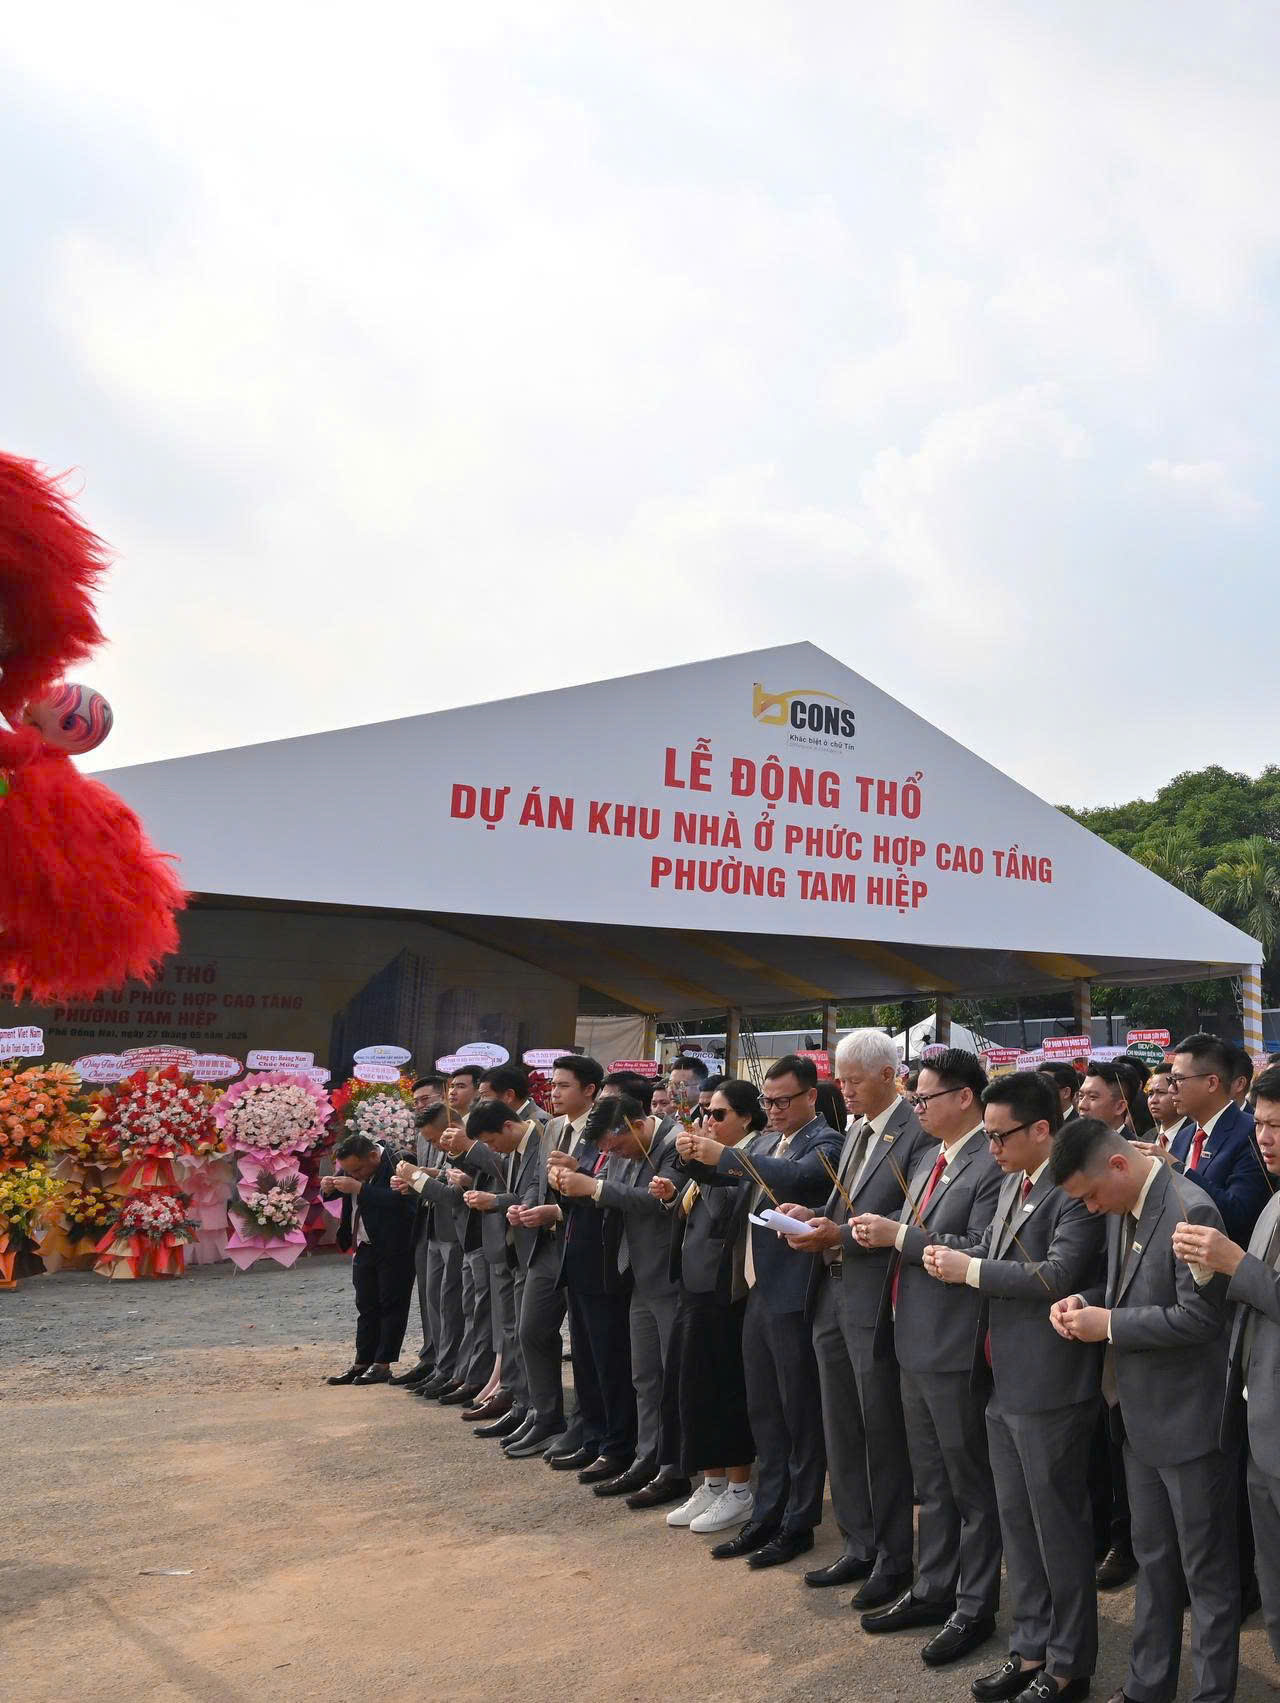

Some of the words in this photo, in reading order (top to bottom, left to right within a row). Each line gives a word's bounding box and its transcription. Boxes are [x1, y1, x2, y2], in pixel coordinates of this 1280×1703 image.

[664, 736, 713, 793] LỄ
[731, 754, 841, 809] ĐỘNG
[856, 771, 926, 820] THỔ
[450, 784, 511, 831] DỰ
[519, 786, 575, 830] ÁN
[588, 801, 661, 841] KHU
[673, 809, 742, 849] NHÀ
[754, 811, 776, 852] Ở
[785, 822, 863, 863] PHỨC
[873, 834, 927, 874] HỢP
[936, 843, 985, 874] CAO
[992, 843, 1053, 884] TẦNG
[651, 855, 786, 899] PHƯỜNG
[798, 870, 857, 904] TAM
[867, 874, 929, 914] HIỆP
[53, 1005, 129, 1023] PHƯỜNG
[136, 1010, 171, 1024] TAM
[224, 993, 255, 1008] CAO
[146, 1030, 158, 1038] 27
